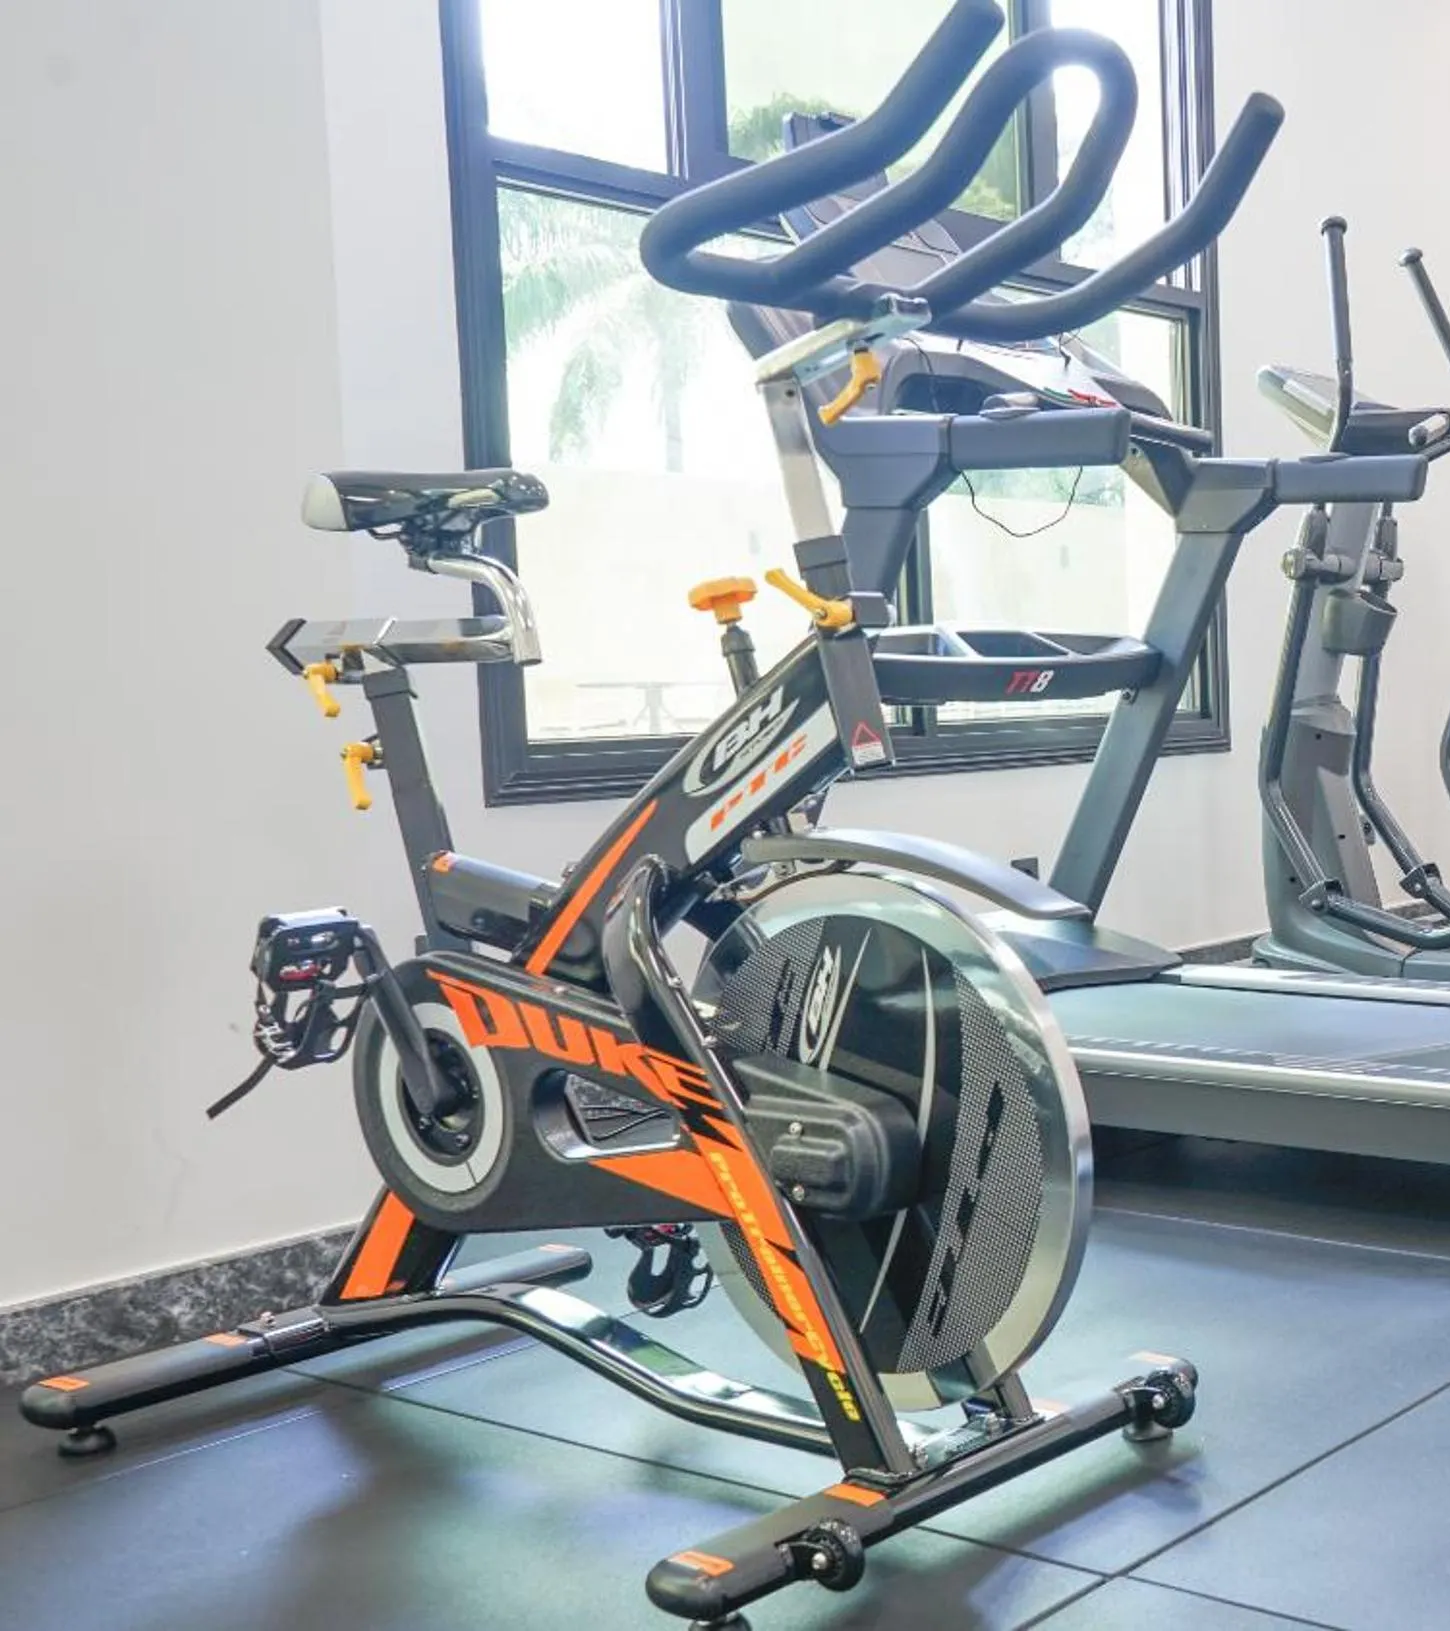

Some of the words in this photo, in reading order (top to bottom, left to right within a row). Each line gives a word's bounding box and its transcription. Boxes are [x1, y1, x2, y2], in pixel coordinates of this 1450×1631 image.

[1006, 670, 1054, 694] TT8
[712, 685, 784, 772] BH
[425, 967, 729, 1110] DUKE
